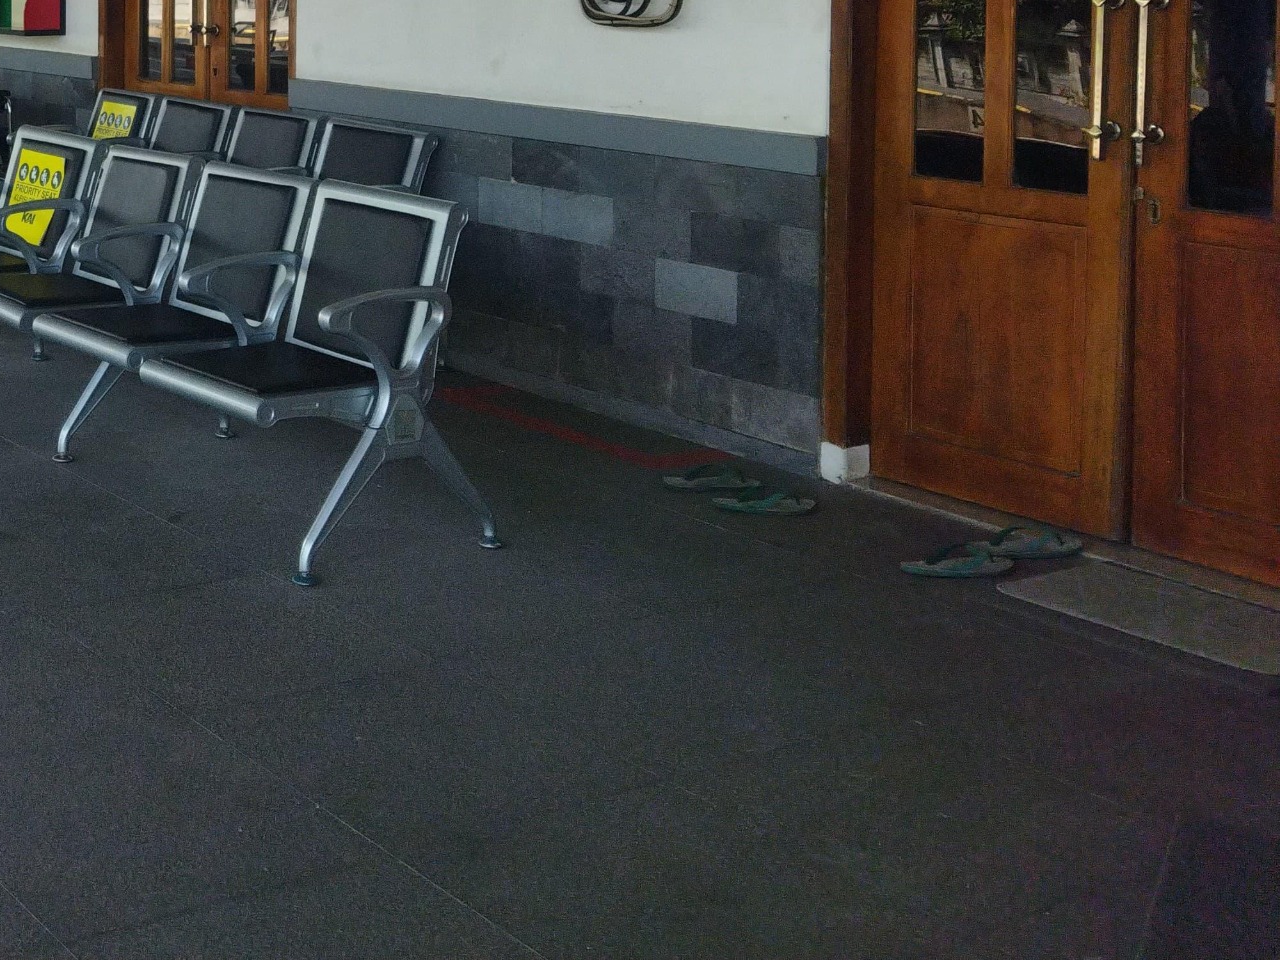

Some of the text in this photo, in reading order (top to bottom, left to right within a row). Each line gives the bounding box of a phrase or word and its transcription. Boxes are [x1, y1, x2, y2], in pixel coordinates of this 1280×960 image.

[15, 183, 41, 197] PRIORITY
[40, 190, 57, 200] SEAT
[21, 211, 36, 224] KAI
